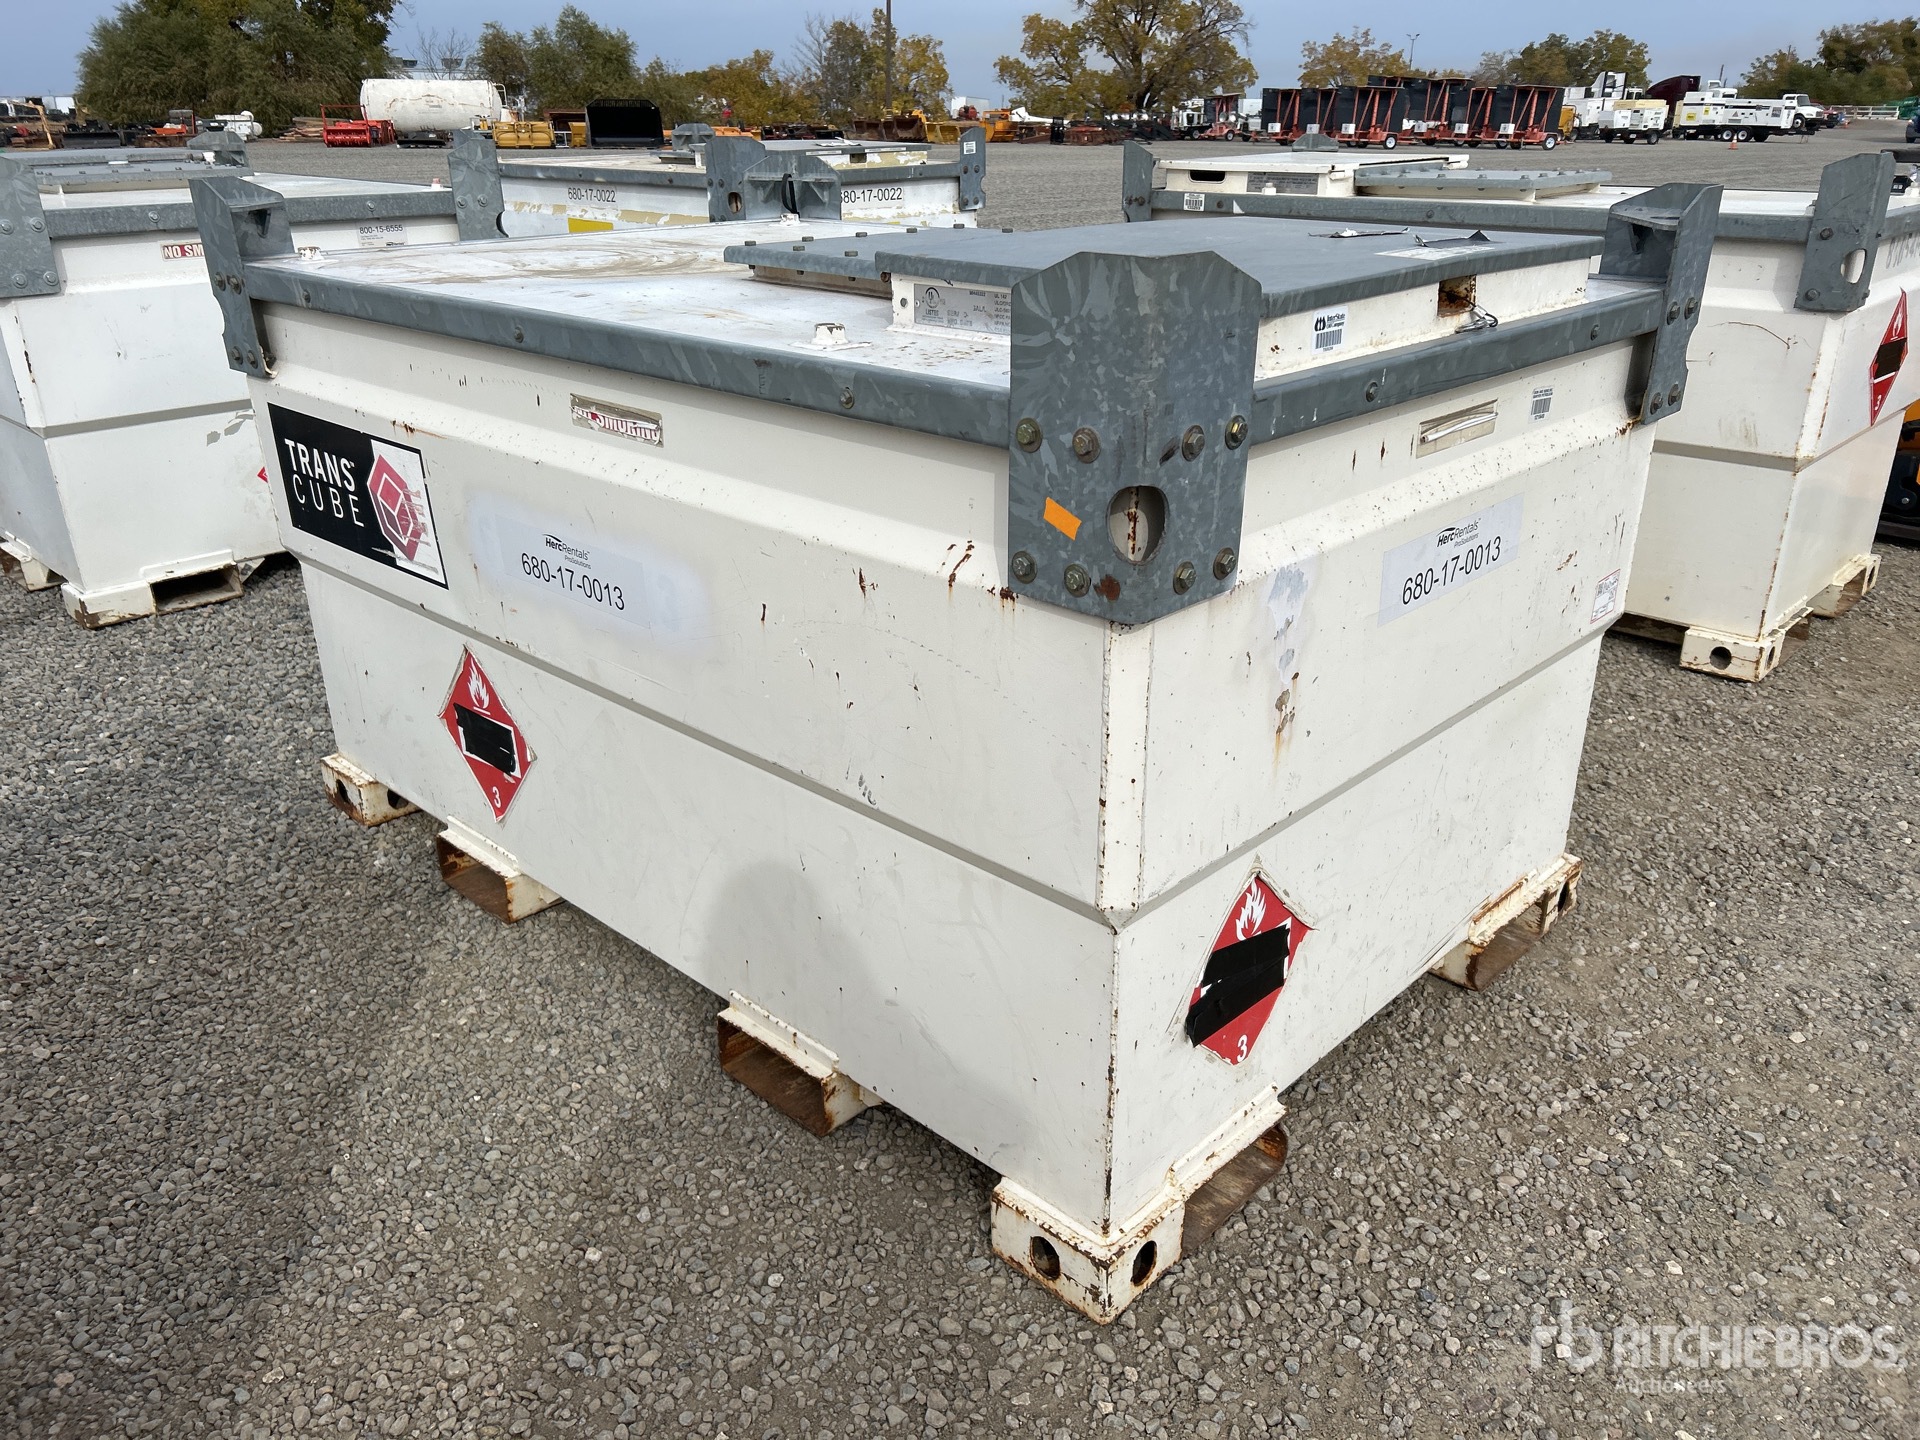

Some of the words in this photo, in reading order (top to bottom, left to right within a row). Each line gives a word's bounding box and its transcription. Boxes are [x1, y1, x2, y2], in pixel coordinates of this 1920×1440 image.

[568, 187, 616, 203] 680-17-0022
[359, 224, 404, 235] 800-15-6555
[164, 245, 182, 259] NO
[1874, 393, 1882, 411] 3
[284, 438, 356, 492] TRANS
[292, 473, 365, 527] CUBE
[521, 552, 625, 611] 680-17-0013
[1402, 535, 1501, 605] 680-17-0013
[492, 786, 502, 808] 3
[1236, 1034, 1248, 1063] 3
